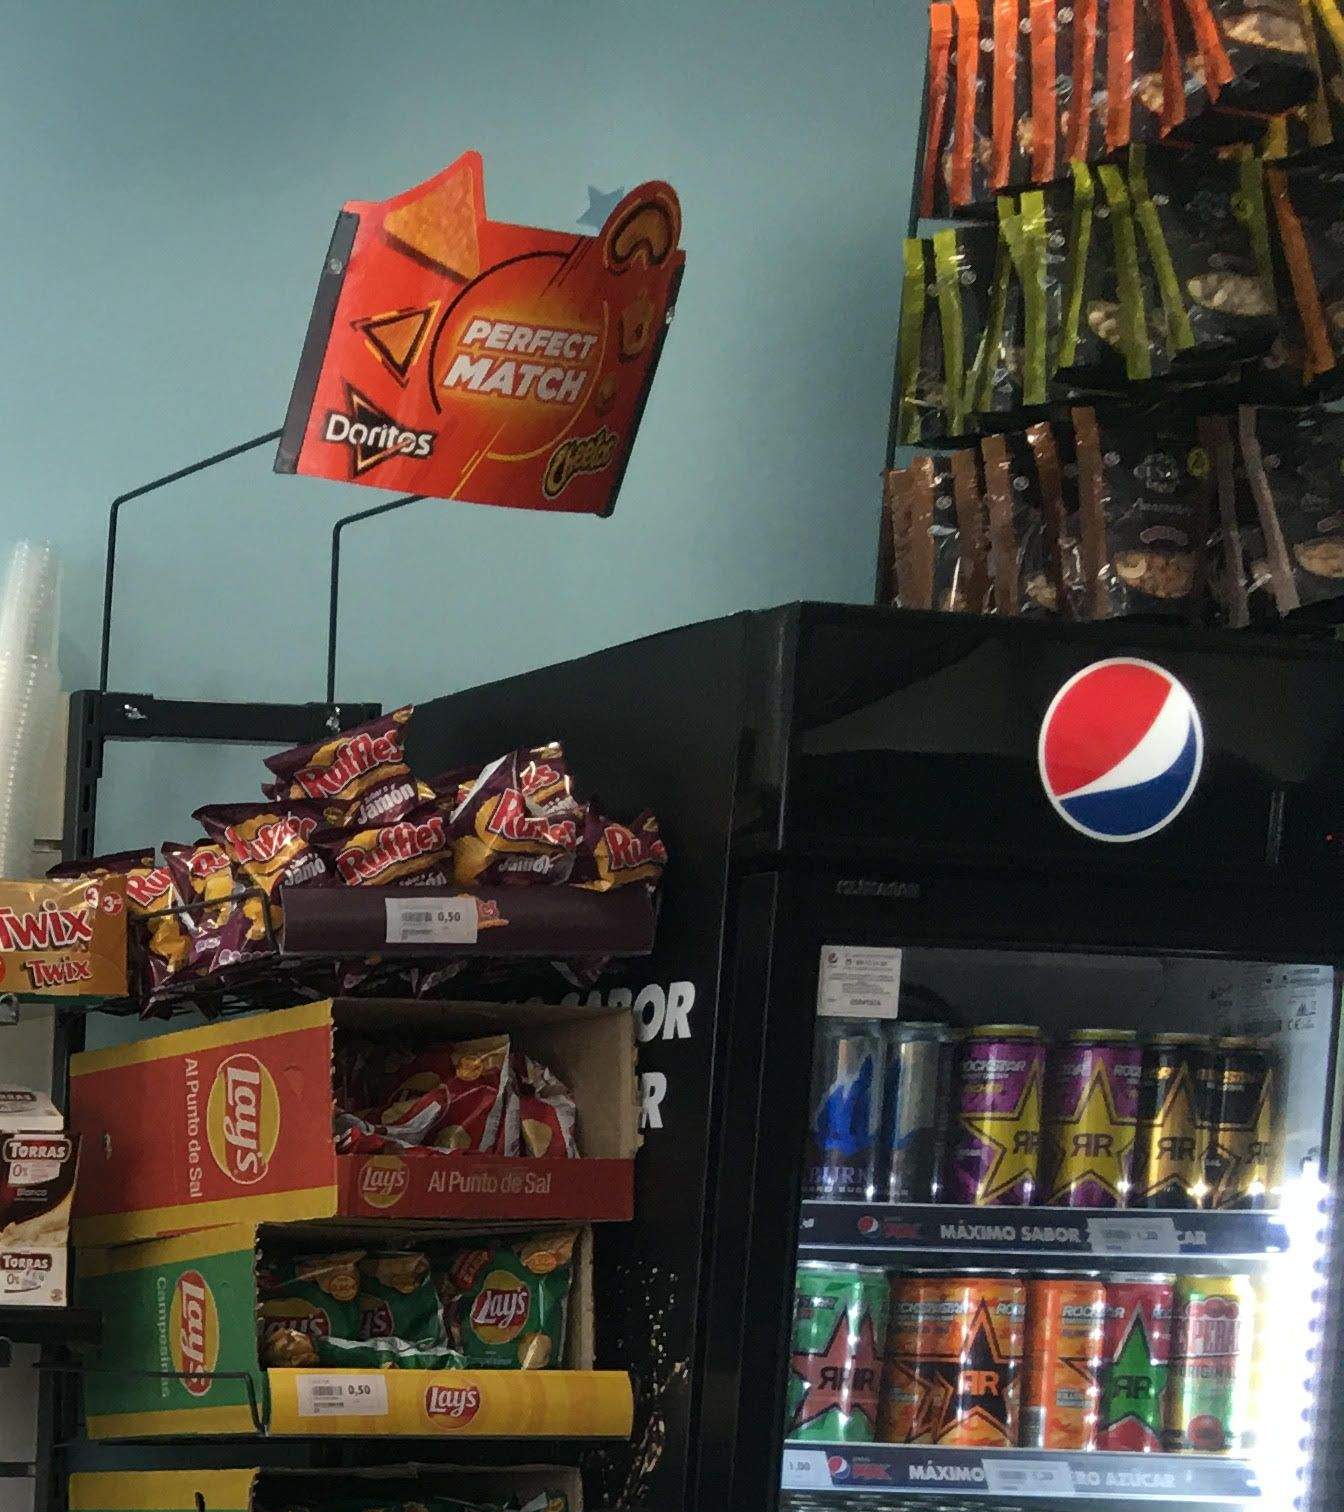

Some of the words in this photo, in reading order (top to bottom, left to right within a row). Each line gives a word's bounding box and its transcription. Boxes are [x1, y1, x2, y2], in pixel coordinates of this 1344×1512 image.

[462, 319, 598, 359] PERFECT
[443, 355, 589, 403] MATCH
[325, 413, 435, 456] Doritos
[296, 730, 406, 800] Ruffles
[356, 782, 416, 826] Jamón
[337, 817, 447, 887] Ruffles
[438, 911, 461, 923] 0,50
[26, 957, 92, 988] Twix
[185, 1058, 201, 1080] Al
[185, 1083, 202, 1130] Punto
[220, 1062, 265, 1176] Lay's
[9, 1141, 66, 1158] TORRAS
[187, 1136, 202, 1159] de
[189, 1166, 203, 1198] Sal
[362, 1164, 407, 1195] Lay's
[428, 1169, 445, 1193] Al
[448, 1169, 499, 1193] Punto
[502, 1169, 521, 1193] de
[524, 1169, 551, 1193] Sal
[940, 1219, 1017, 1241] MÁXIMO
[1021, 1226, 1081, 1243] SABOR
[2, 1254, 50, 1269] TORRAS
[476, 1287, 529, 1327] Lay's
[180, 1280, 212, 1394] Lay's
[346, 1382, 371, 1397] 0,50
[429, 1385, 479, 1414] Lay's
[909, 1459, 985, 1482] MÁXIMO
